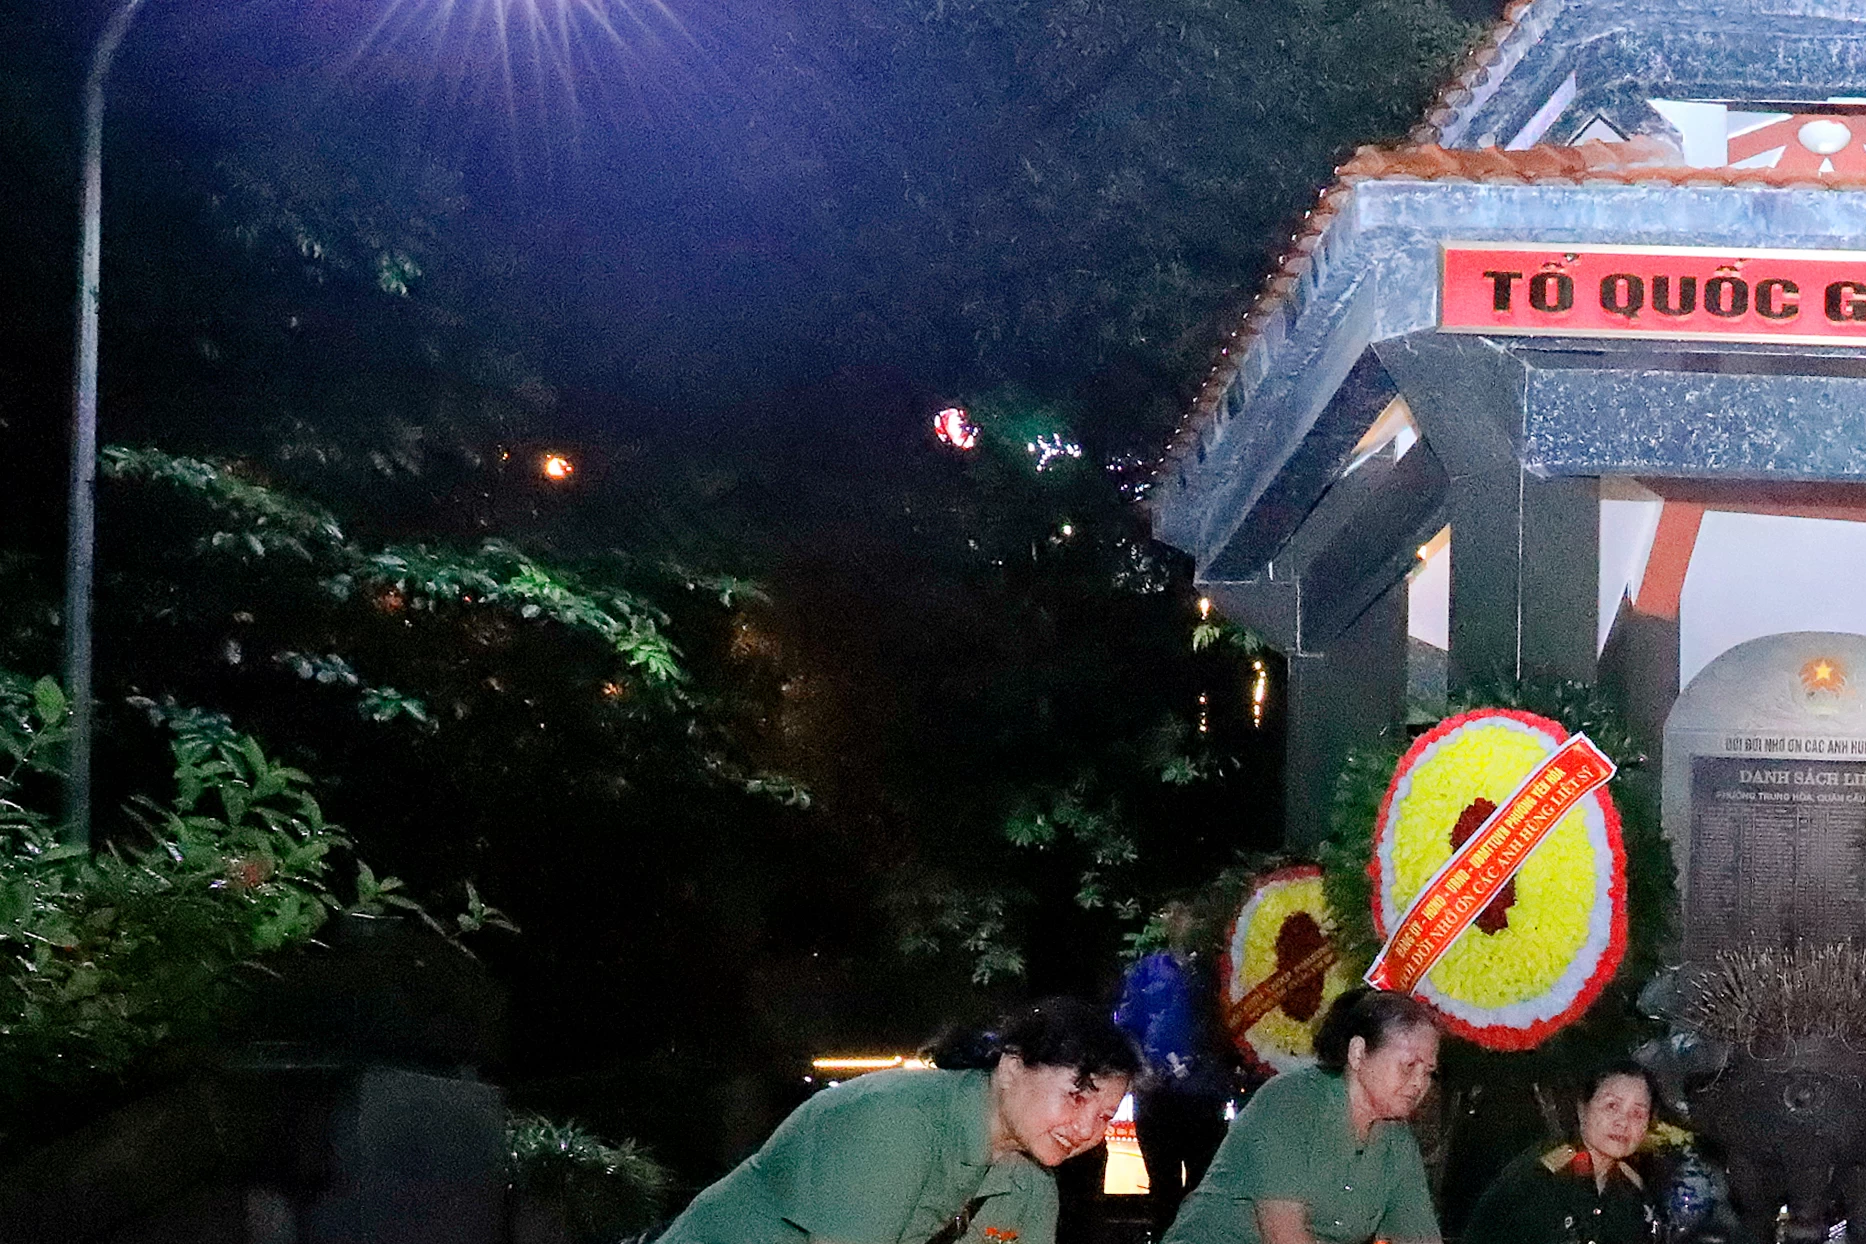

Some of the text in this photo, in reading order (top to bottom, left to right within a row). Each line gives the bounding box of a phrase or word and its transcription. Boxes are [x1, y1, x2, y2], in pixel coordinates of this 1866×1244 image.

[1483, 253, 1579, 314] TỔ
[1600, 258, 1799, 320] QUỐC
[1739, 769, 1790, 784] DANH
[1793, 767, 1839, 785] SÁCH
[1827, 739, 1848, 754] ANH
[1421, 894, 1447, 920] HĐND
[1445, 869, 1471, 893] UBND
[1504, 795, 1538, 829] PHƯỜNG
[1430, 908, 1459, 941] NHỚ
[1455, 891, 1477, 913] ƠN
[1472, 866, 1500, 894] CÁC
[1497, 839, 1525, 869] ANH
[1519, 804, 1555, 841] HÙNG
[1551, 777, 1581, 806] LIỆT
